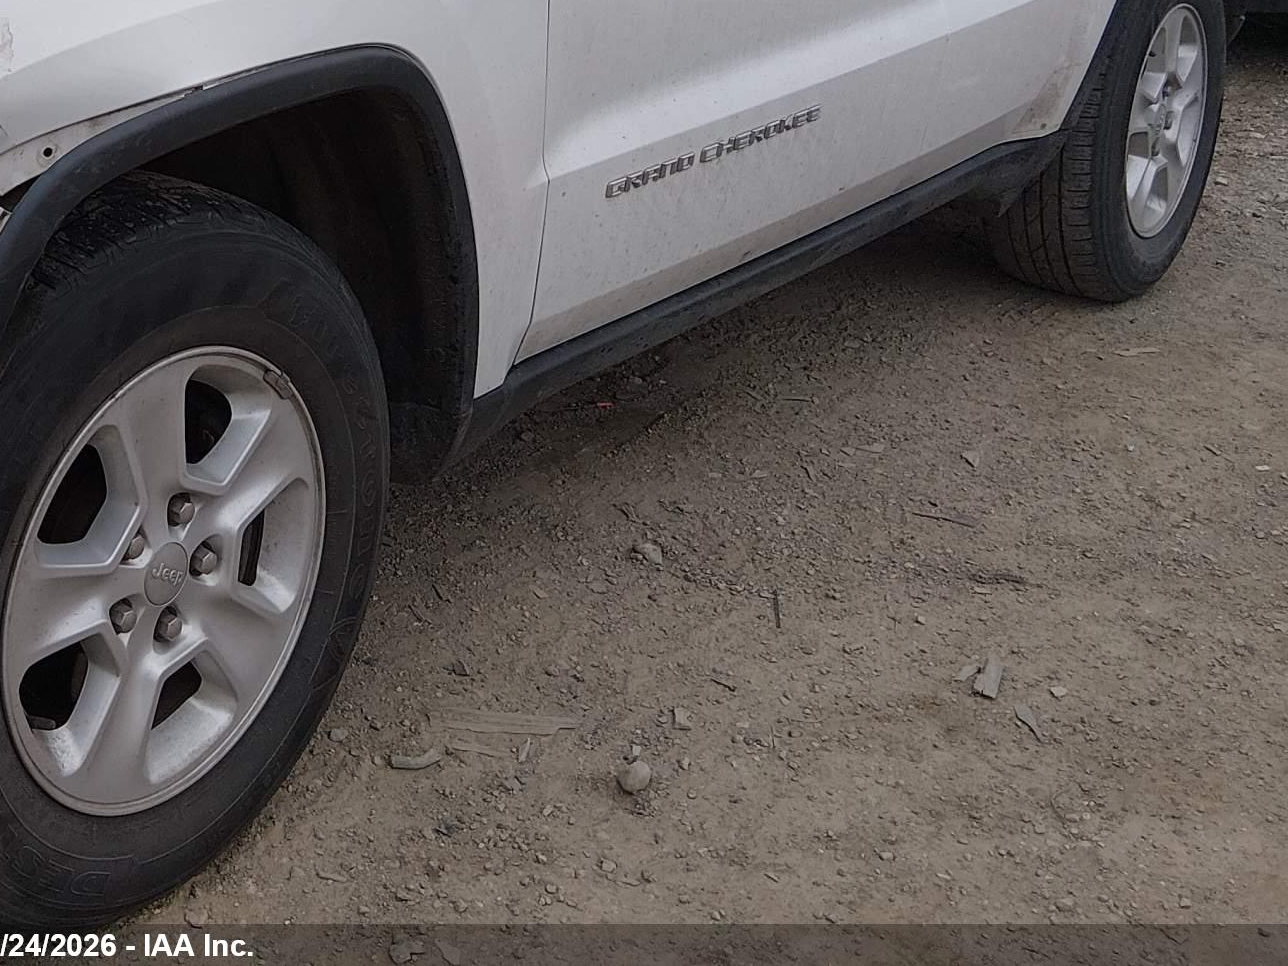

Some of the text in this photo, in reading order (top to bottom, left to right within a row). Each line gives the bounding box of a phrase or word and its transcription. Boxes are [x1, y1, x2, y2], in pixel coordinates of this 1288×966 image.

[604, 103, 822, 199] GRAND CHEROKEE
[151, 561, 185, 587] Jeep
